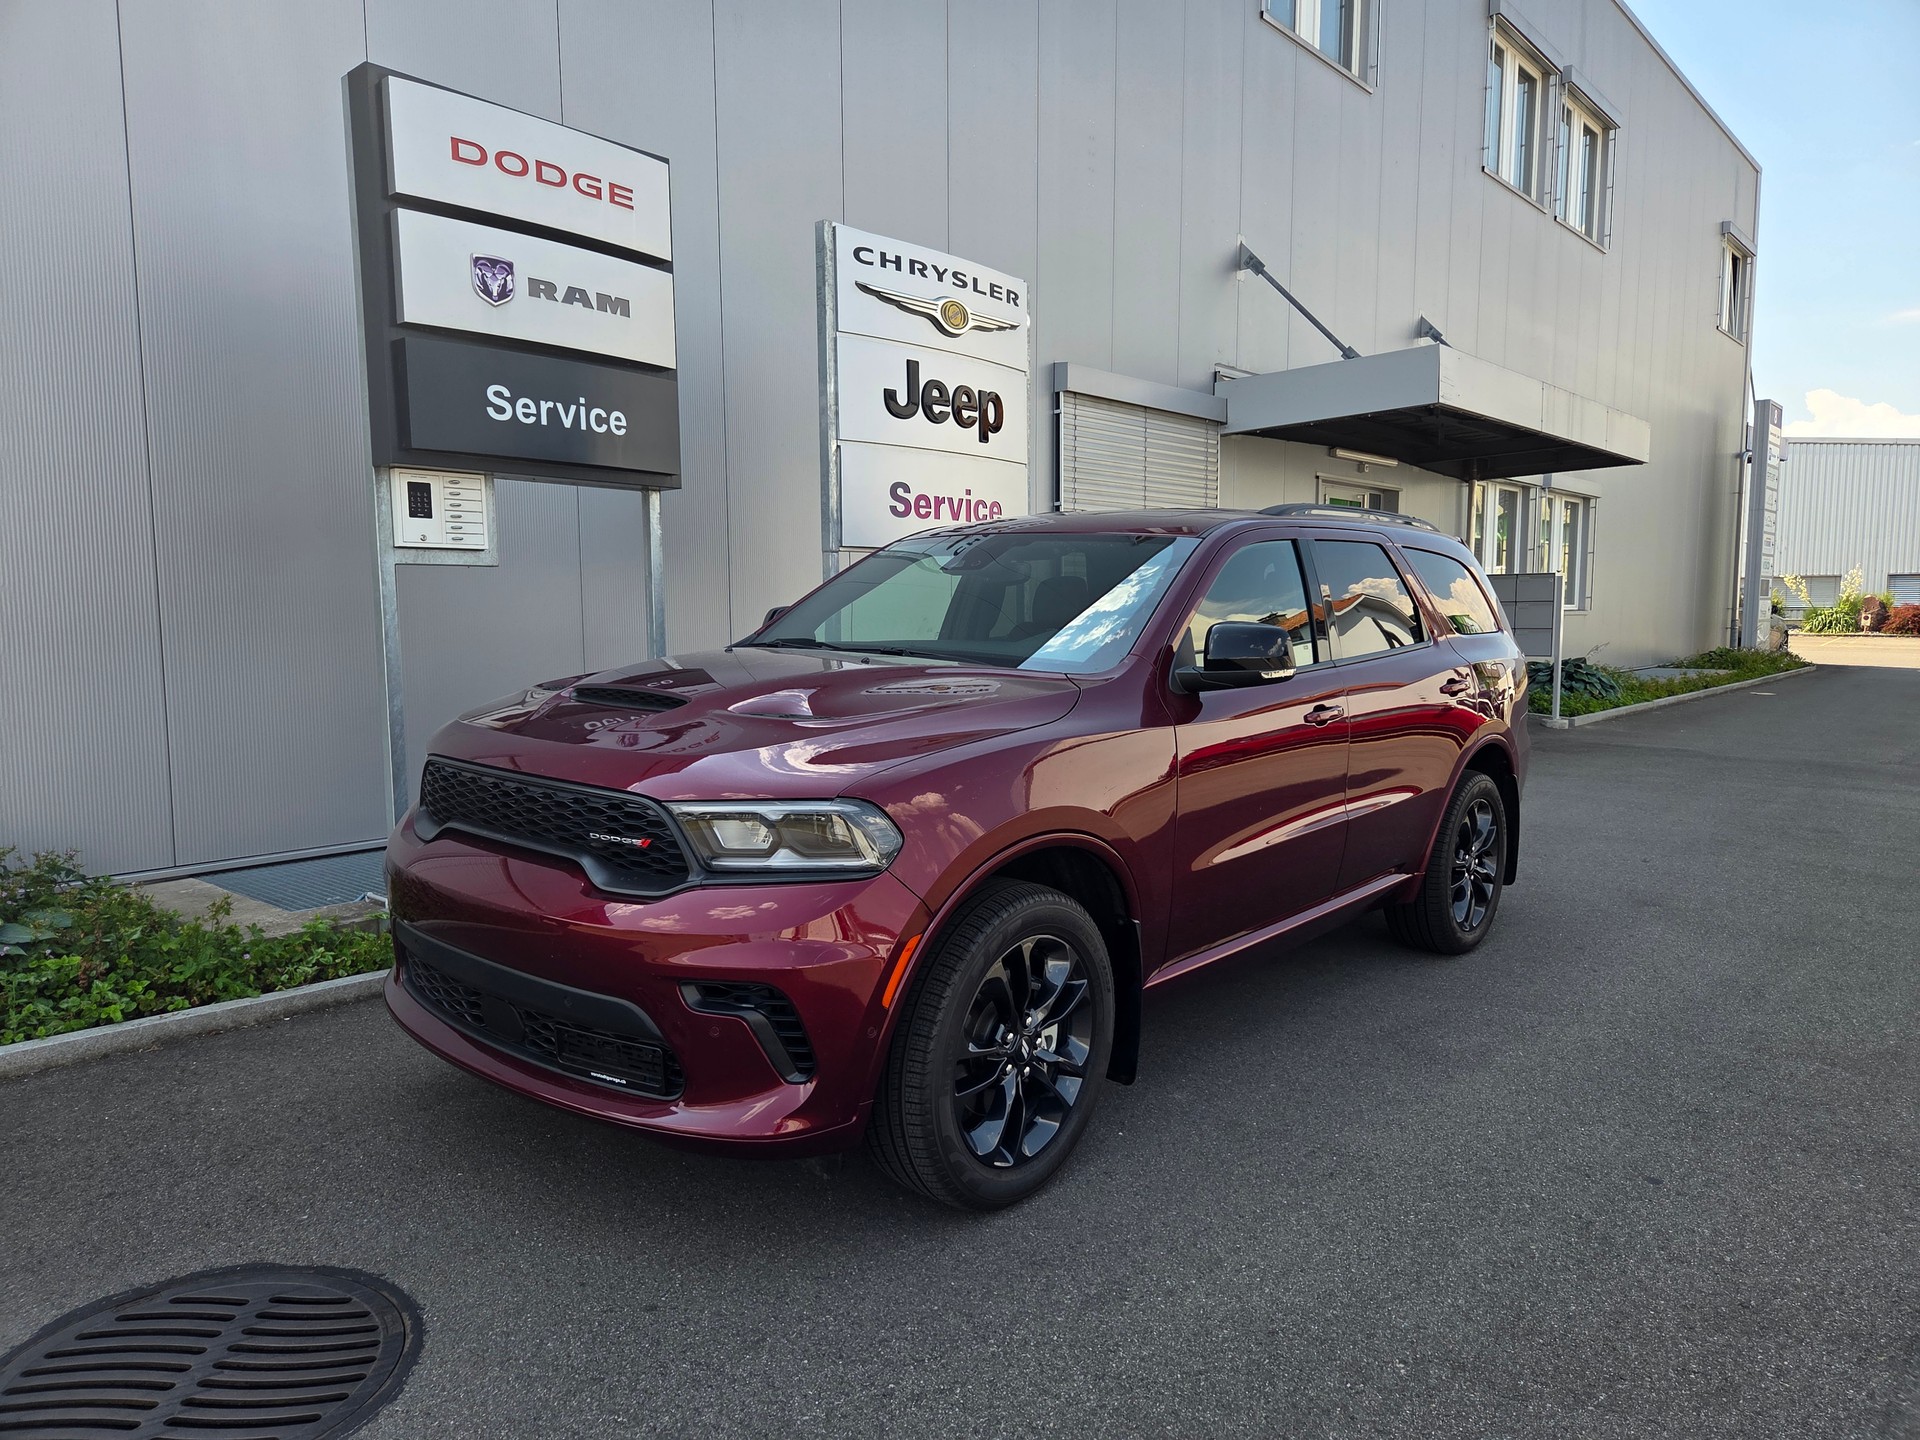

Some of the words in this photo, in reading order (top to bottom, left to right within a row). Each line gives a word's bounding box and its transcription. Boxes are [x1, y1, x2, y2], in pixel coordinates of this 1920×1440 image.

[450, 136, 635, 211] DODGE
[527, 276, 631, 318] RAM
[852, 246, 1021, 307] CHRYSLER
[486, 384, 628, 436] Service
[883, 358, 1004, 443] Jeep
[889, 481, 1002, 522] Service
[589, 832, 642, 847] DODGE
